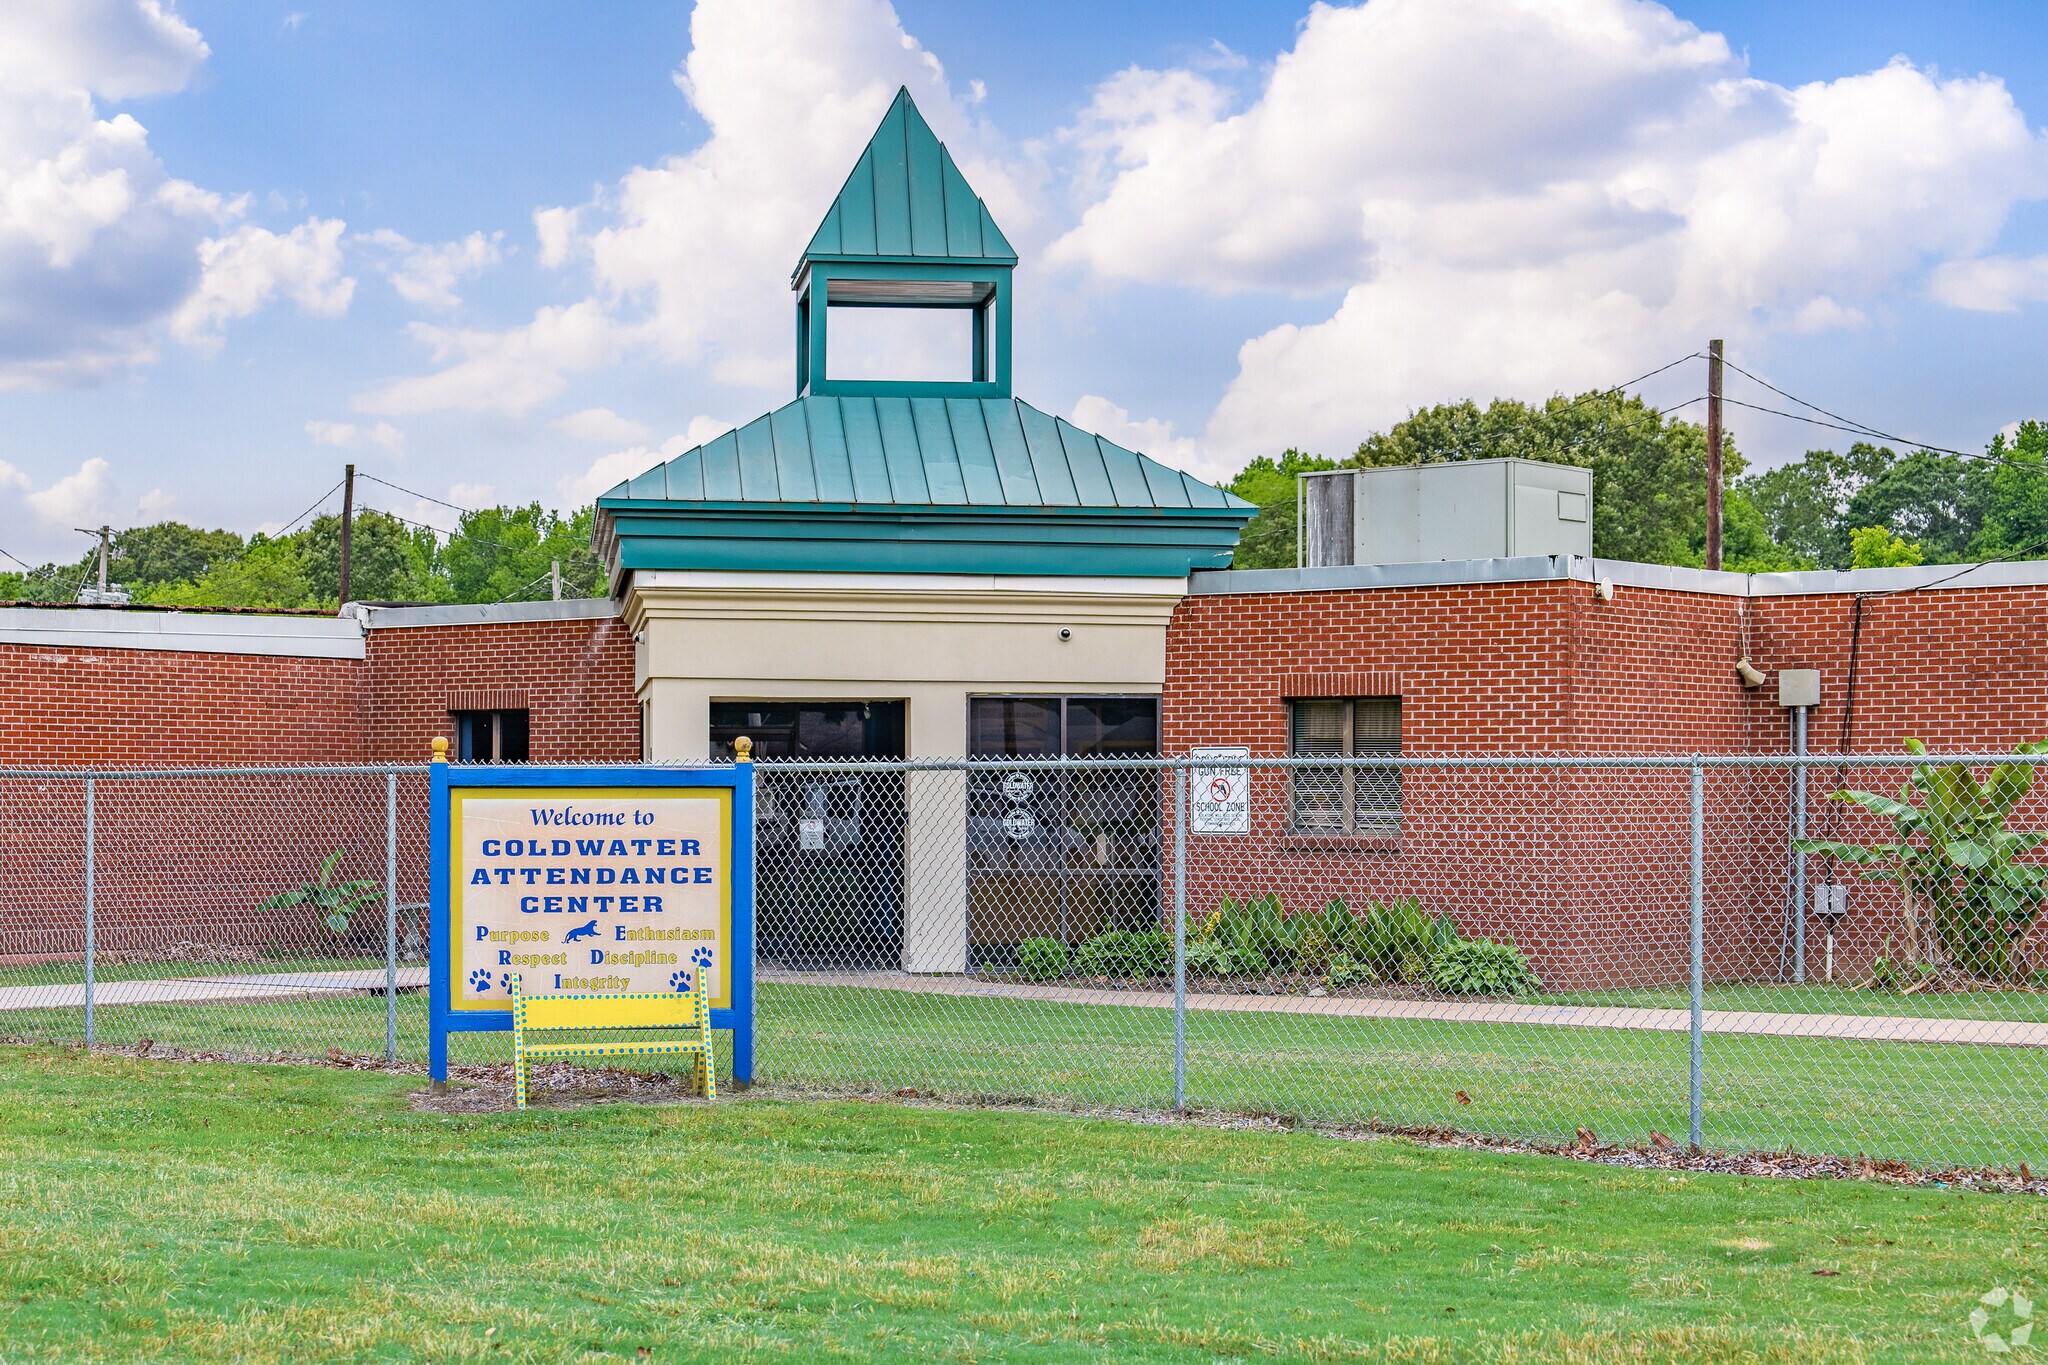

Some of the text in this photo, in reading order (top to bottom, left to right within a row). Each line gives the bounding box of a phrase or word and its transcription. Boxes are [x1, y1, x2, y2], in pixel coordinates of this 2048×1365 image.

[1198, 767, 1216, 776] GUN
[1196, 802, 1245, 812] SCHOOL ZONE
[531, 806, 655, 827] Welcome to
[482, 839, 701, 857] COLDWATER
[471, 867, 713, 885] ATTENDANCE
[520, 896, 663, 913] CENTER
[475, 926, 549, 944] Purpose
[615, 926, 716, 942] Enthusiasm
[498, 950, 678, 968] Respect Discipline
[554, 974, 630, 991] Integrity
